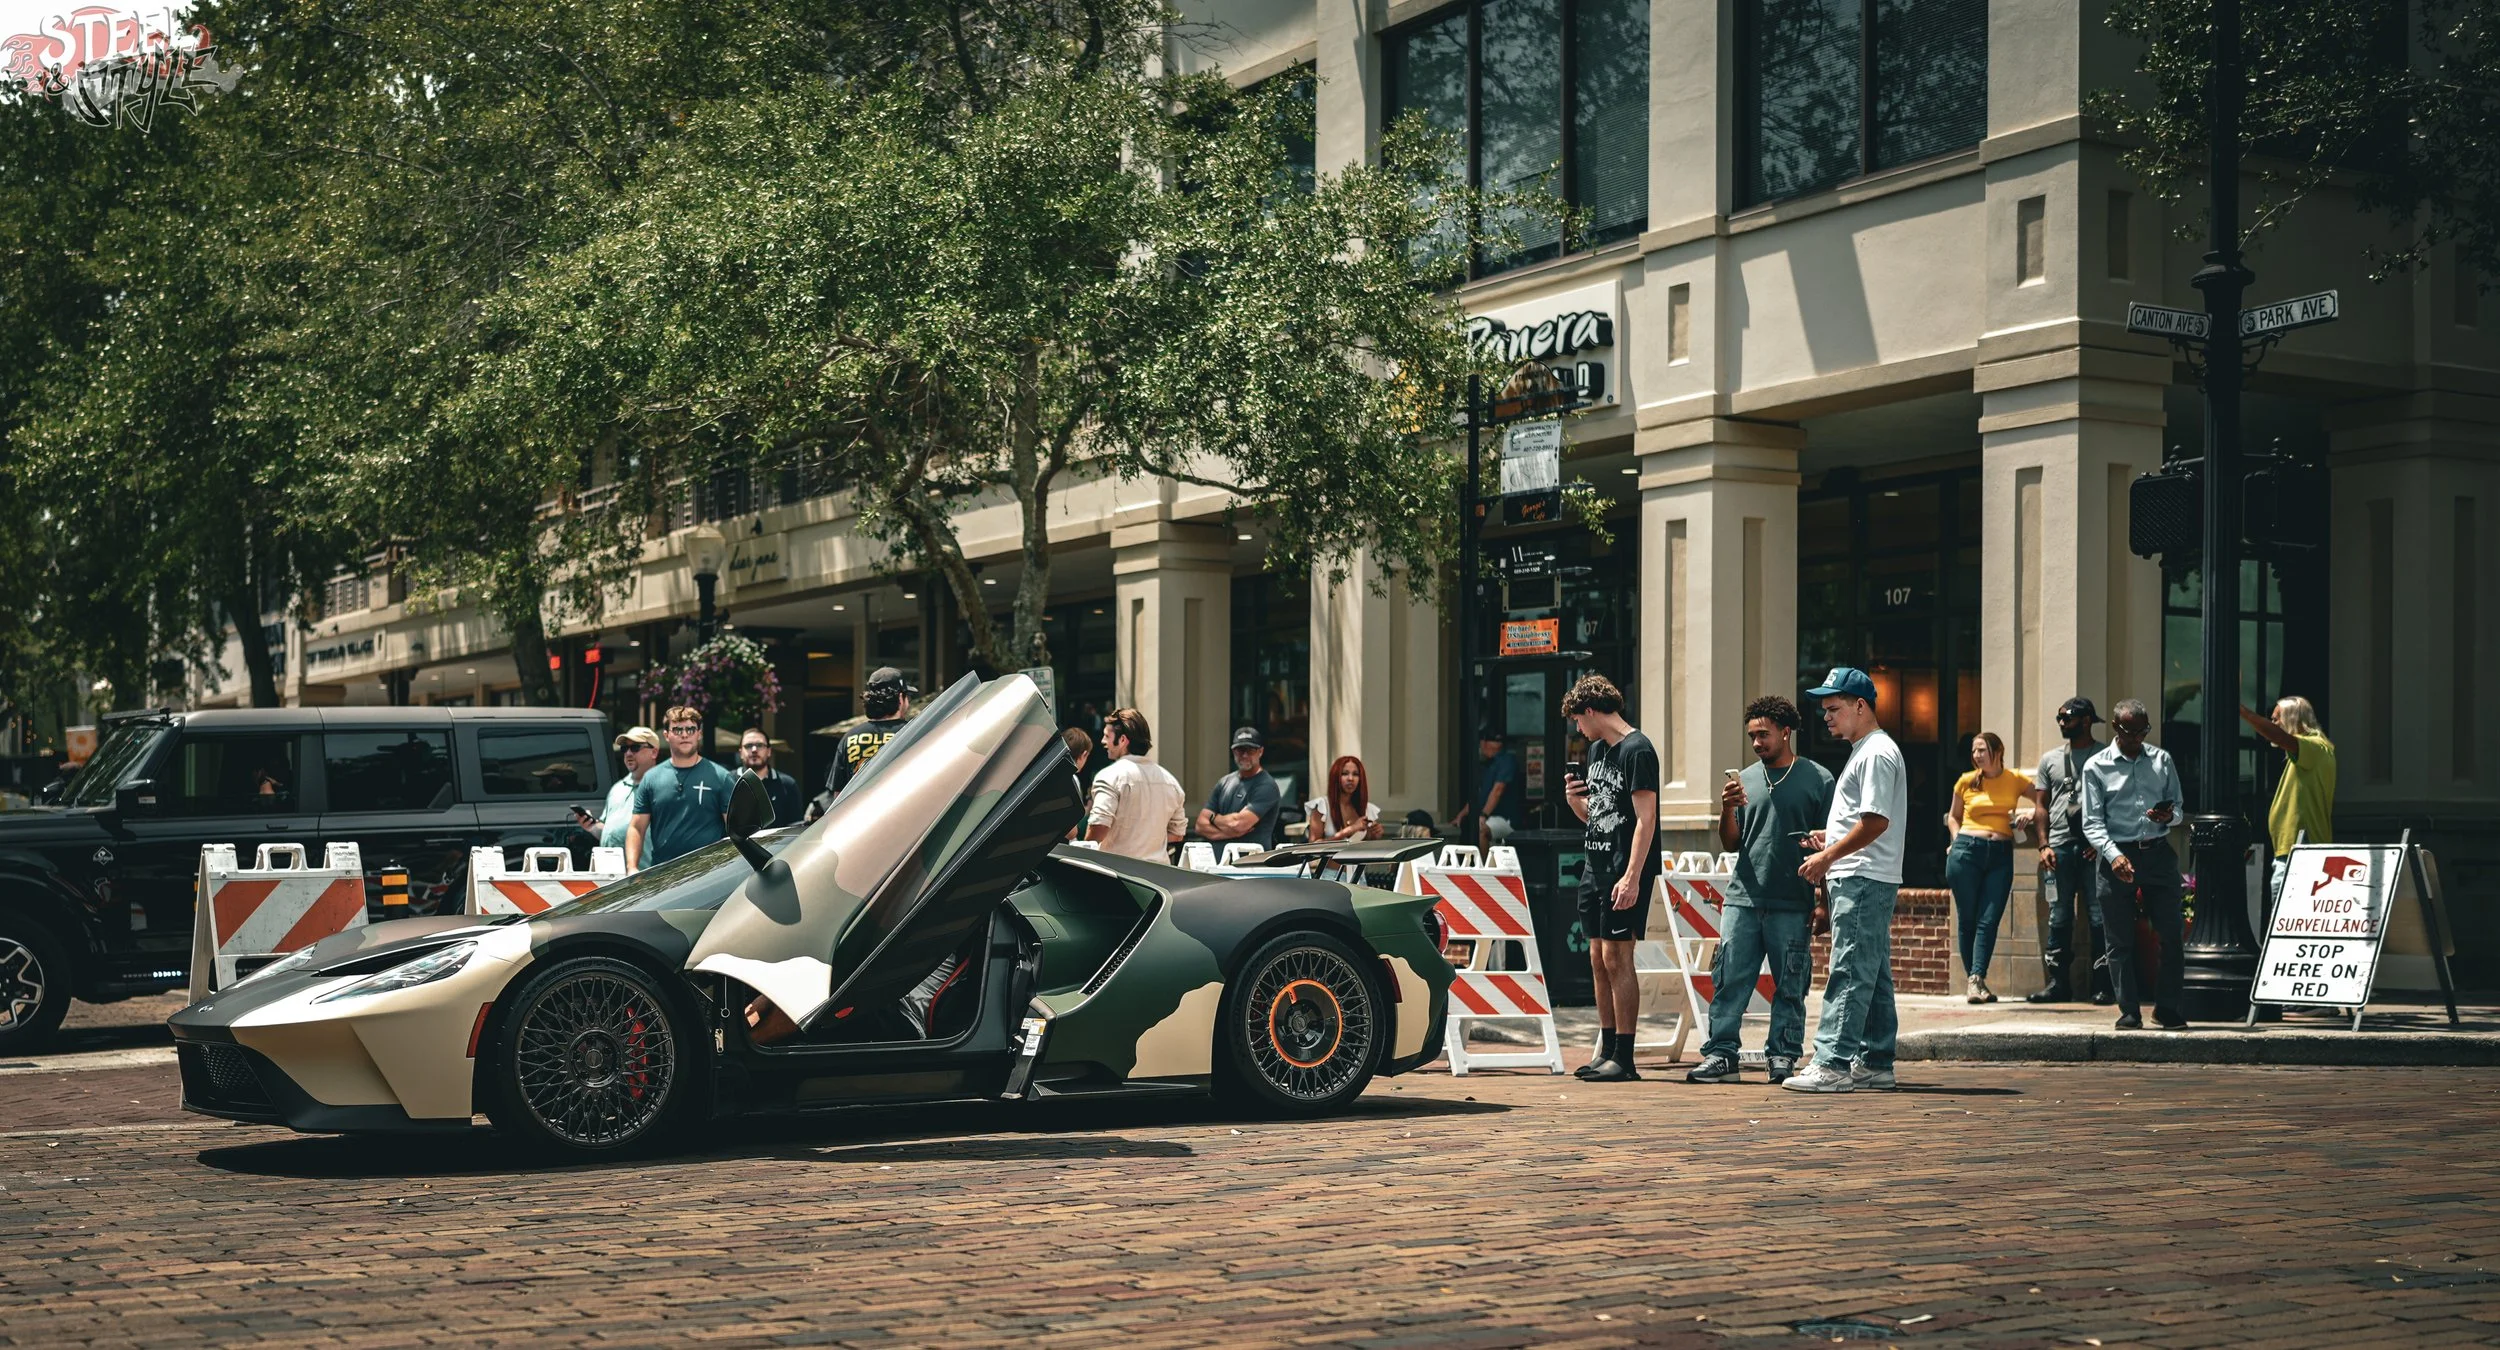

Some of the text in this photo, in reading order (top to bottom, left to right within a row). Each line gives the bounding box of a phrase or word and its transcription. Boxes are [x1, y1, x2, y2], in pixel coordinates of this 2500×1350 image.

[2134, 308, 2194, 333] CANTON AVE
[2259, 297, 2328, 329] PARK AVE
[1466, 310, 1604, 363] Panera
[1885, 588, 1911, 605] 107
[1584, 621, 1598, 635] 07
[847, 732, 895, 748] ROLE
[847, 745, 879, 763] 24
[2313, 899, 2352, 913] VIDEO
[2276, 918, 2379, 933] SURVEILLANCE
[2295, 944, 2345, 958] STOP
[2273, 962, 2358, 979] HERE ON
[2291, 982, 2329, 997] RED
